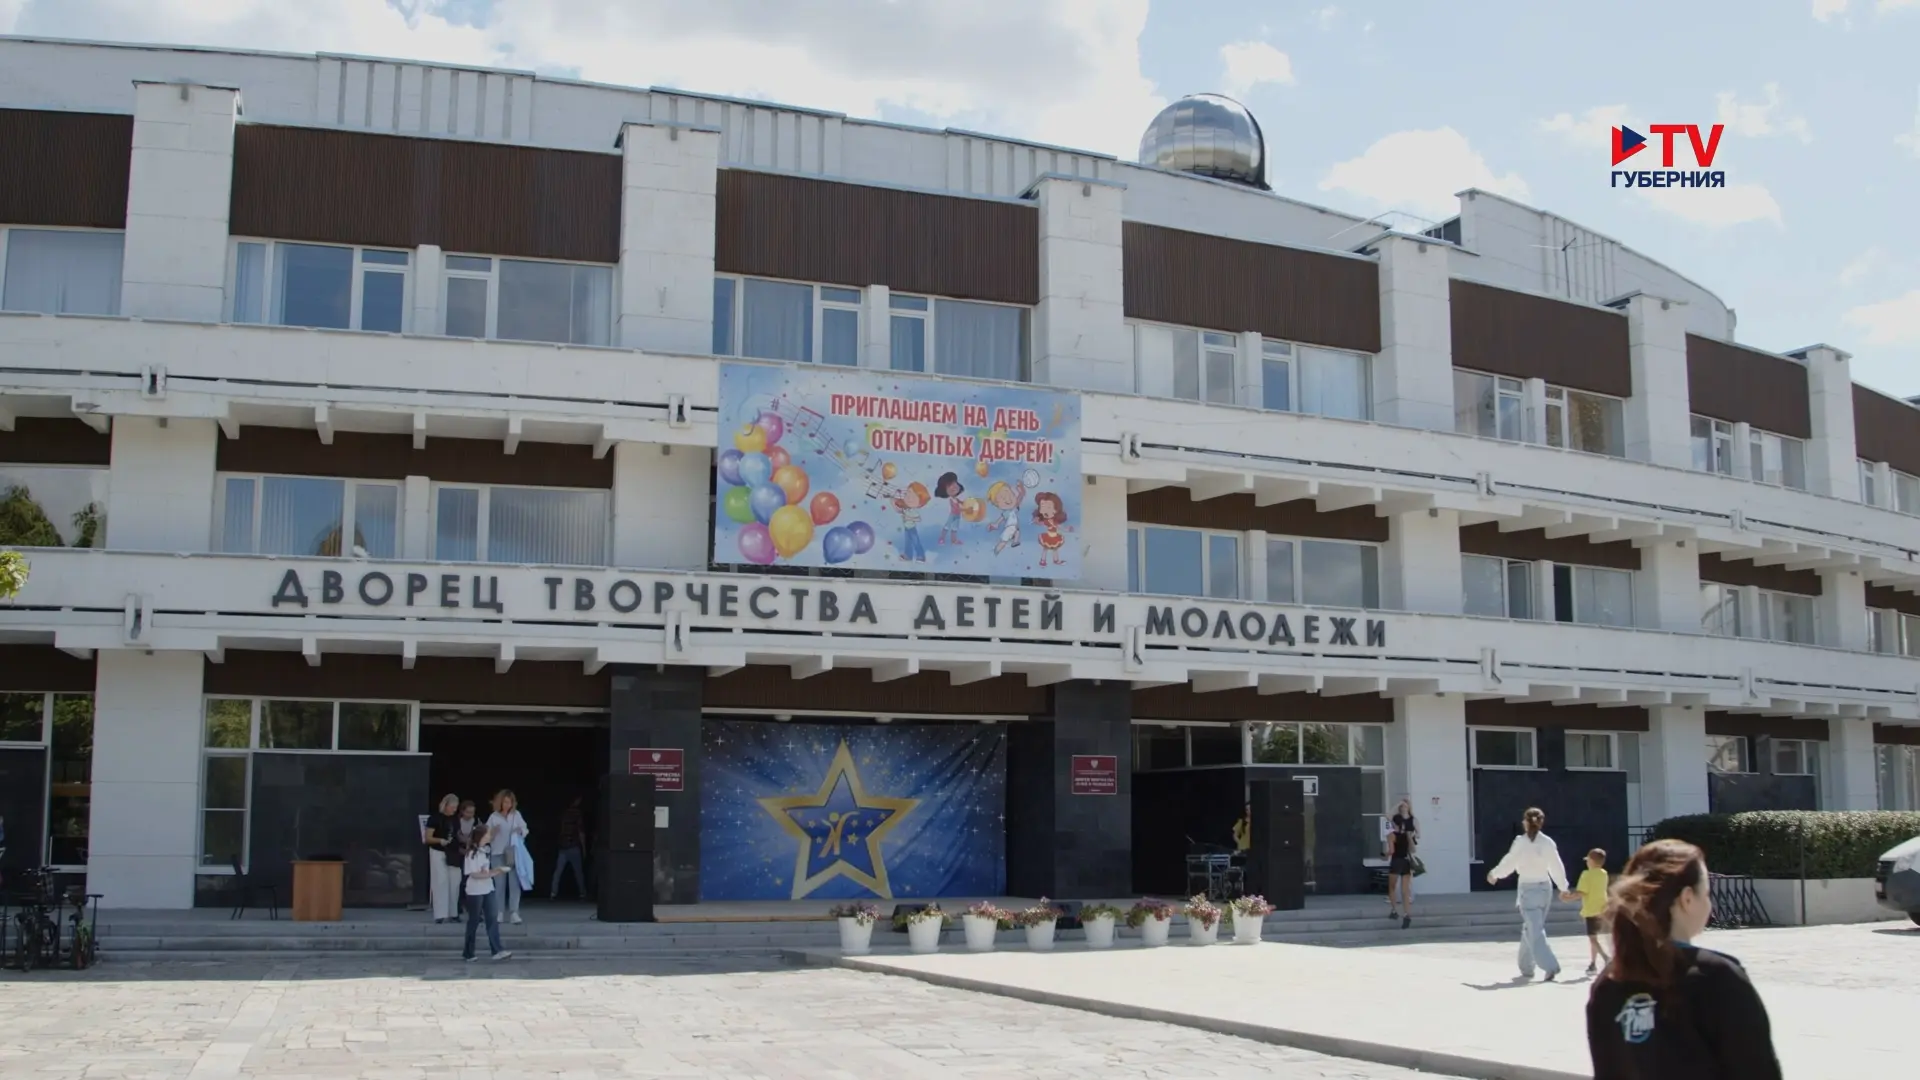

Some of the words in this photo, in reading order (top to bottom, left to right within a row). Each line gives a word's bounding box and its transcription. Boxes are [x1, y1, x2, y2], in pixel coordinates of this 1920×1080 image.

[830, 393, 957, 424] ПРИГЛАШАЕМ
[963, 405, 987, 427] НА
[993, 408, 1040, 432] ДЕНЬ
[871, 429, 974, 458] ОТКРЫТЫХ
[978, 438, 1054, 464] ДВЕРЕЙ!
[272, 569, 504, 614] ДВОРЕЦ
[544, 577, 878, 624] ТВОРЧЕСТВА
[914, 593, 1063, 631] ДЕТЕЙ
[1093, 603, 1115, 633] И
[1146, 605, 1385, 648] МОЛОДЕЖИ
